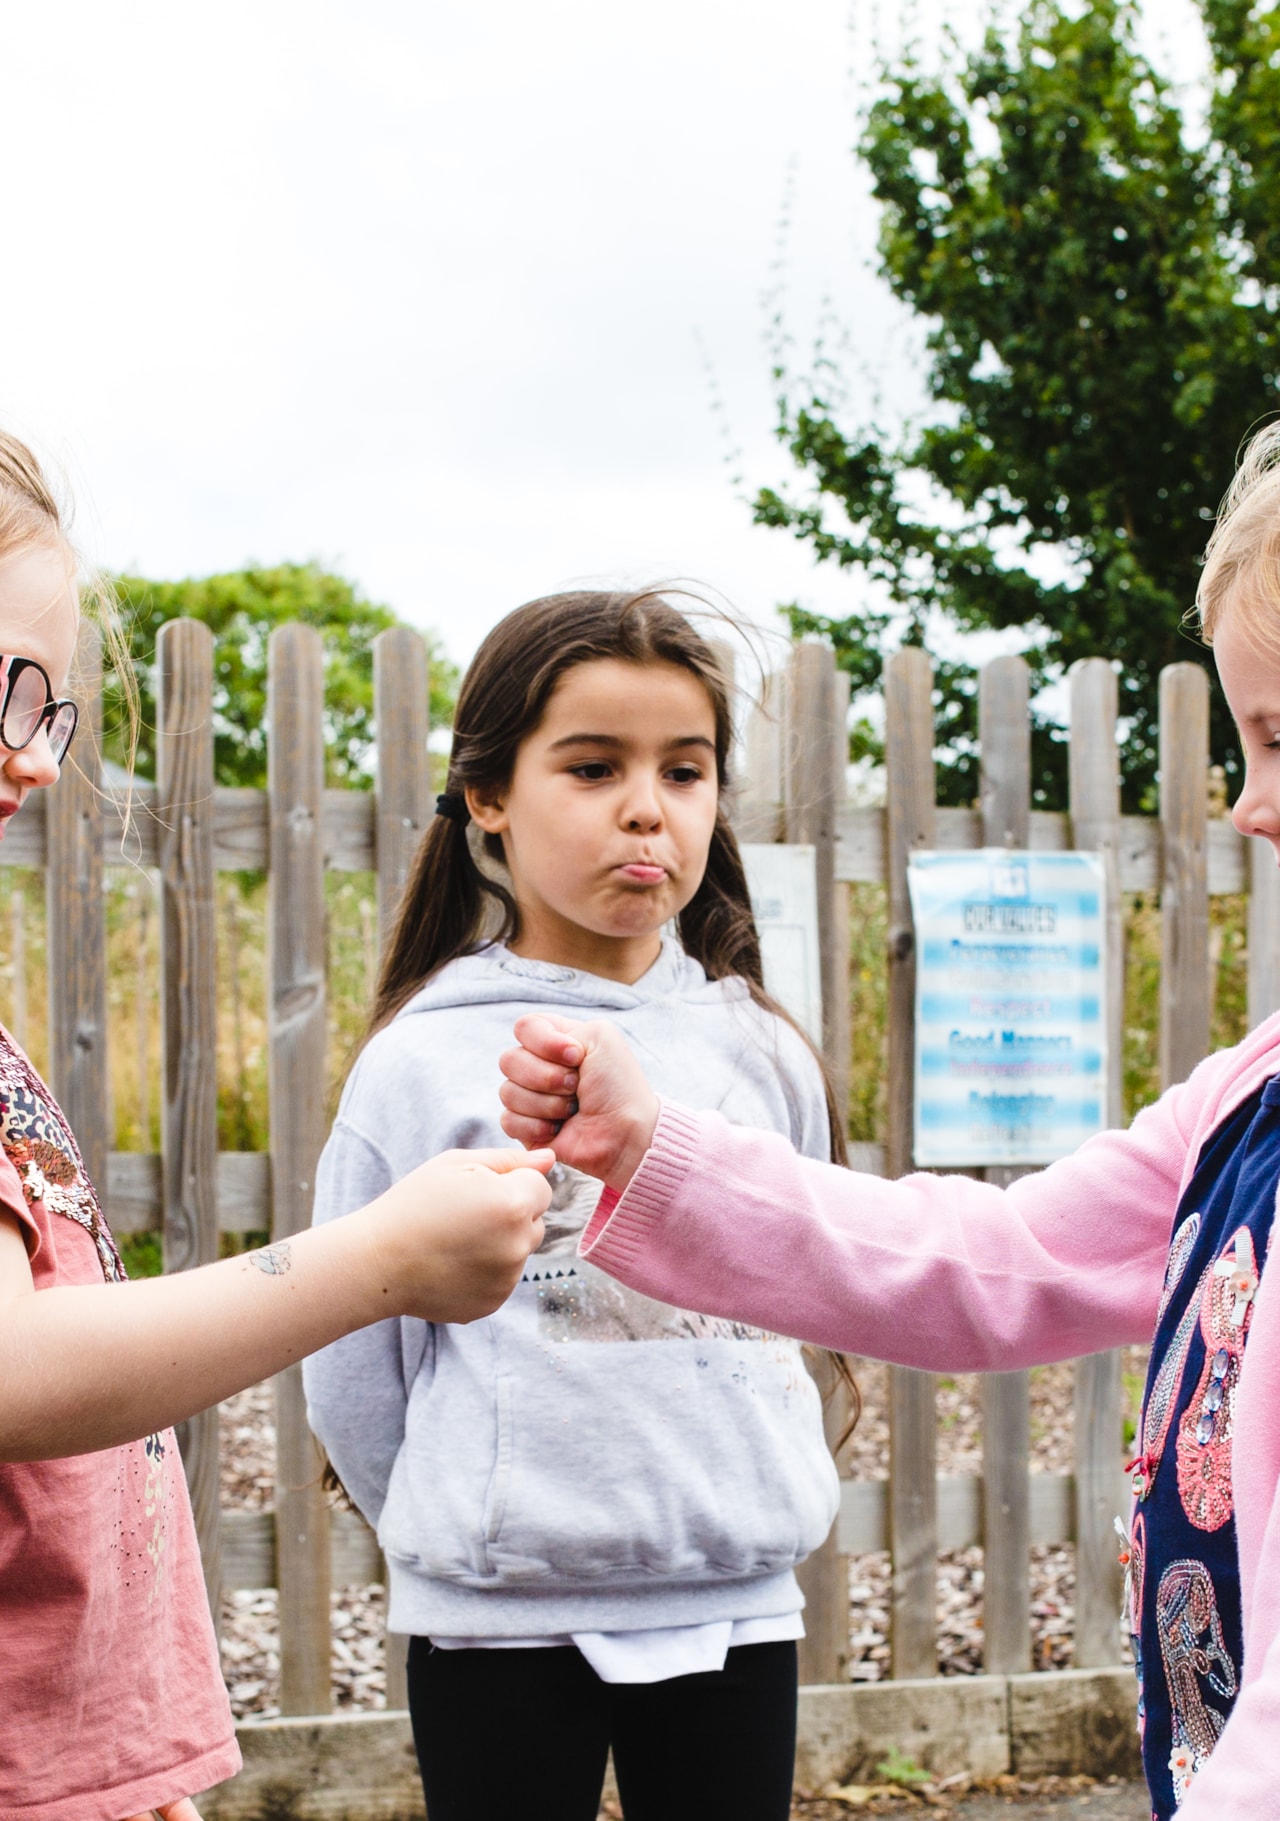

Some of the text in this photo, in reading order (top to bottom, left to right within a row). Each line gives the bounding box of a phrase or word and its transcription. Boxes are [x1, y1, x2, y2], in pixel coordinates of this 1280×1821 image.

[966, 906, 1055, 932] OUR VALUES
[970, 997, 1051, 1022] Respect
[950, 1030, 1071, 1050] Good Manners
